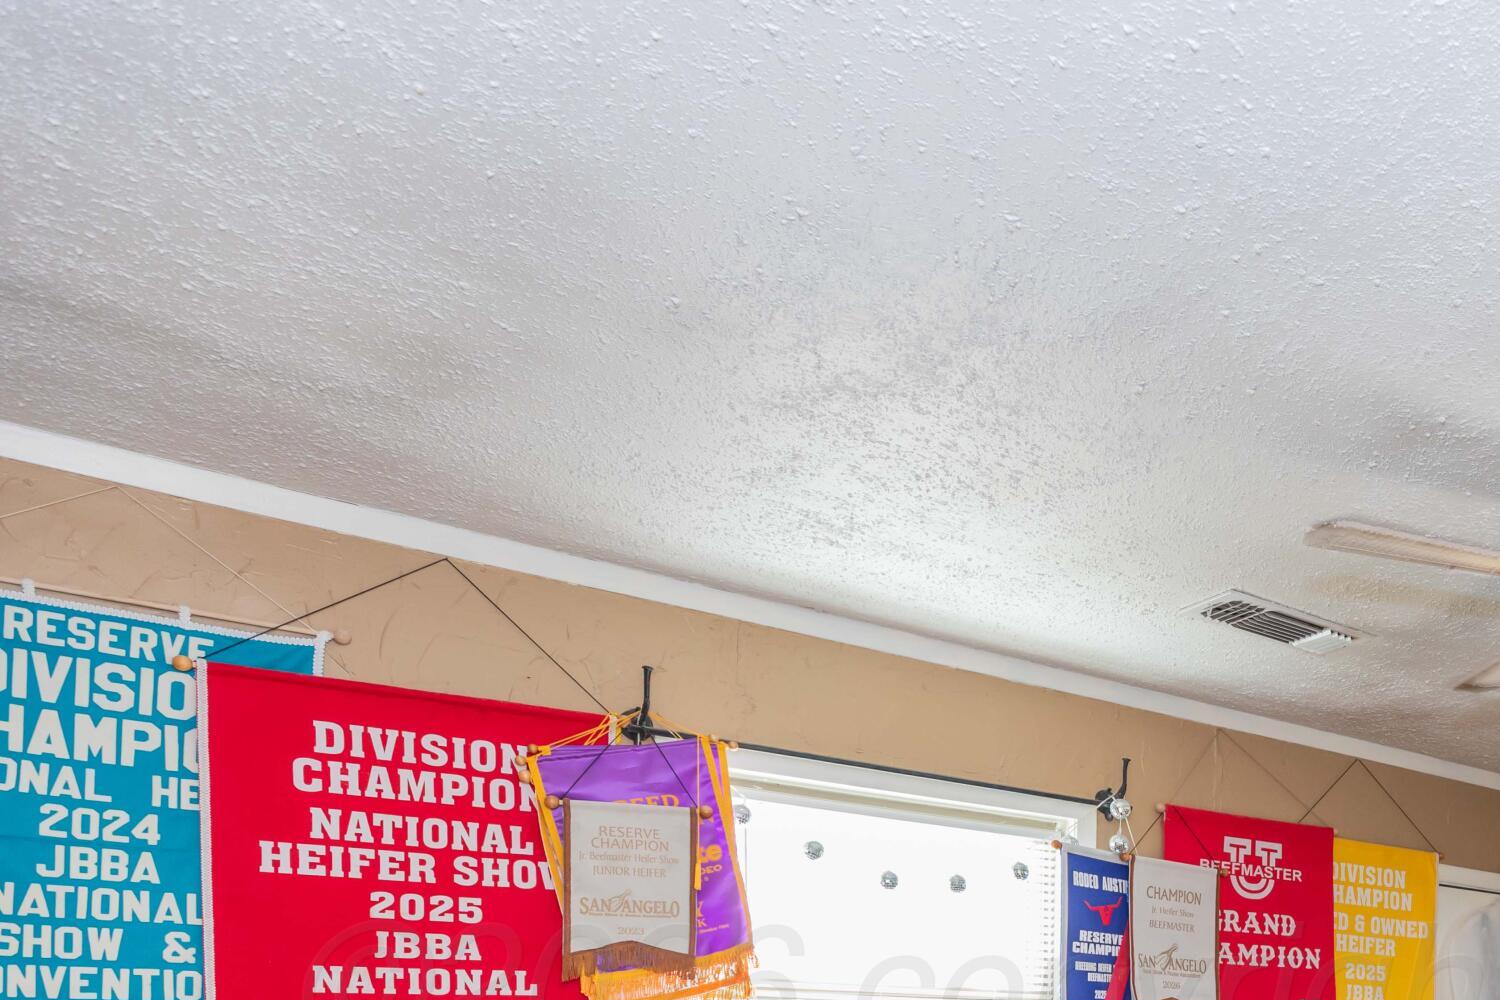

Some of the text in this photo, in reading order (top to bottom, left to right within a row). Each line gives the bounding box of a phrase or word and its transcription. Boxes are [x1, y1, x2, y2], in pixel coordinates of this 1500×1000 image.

[313, 720, 527, 774] DIVISION
[39, 803, 160, 845] 2024
[309, 807, 534, 856] NATIONAL
[599, 825, 661, 840] RESERVE
[591, 838, 669, 851] CHAMPION
[36, 845, 160, 884] JBBA
[258, 841, 436, 884] HEIFER
[593, 865, 666, 879] JUNIOR HEIFER
[1200, 858, 1303, 882] BEEFMASTER
[1073, 871, 1099, 890] RODEO
[369, 892, 482, 923] 2025
[579, 897, 680, 918] SAN ANGELO
[1146, 885, 1202, 906] CHAMPION
[1149, 919, 1195, 933] BEEFMASTER
[1354, 914, 1365, 935] &
[1371, 916, 1428, 939] OWNED
[0, 922, 196, 964] SHOW &
[375, 931, 481, 961] JBBA
[1336, 933, 1396, 957] HEIFER
[1138, 953, 1156, 968] SAN
[1168, 957, 1207, 975] ANGELO
[1345, 963, 1386, 982] 2025
[312, 965, 538, 996] NATIONAL
